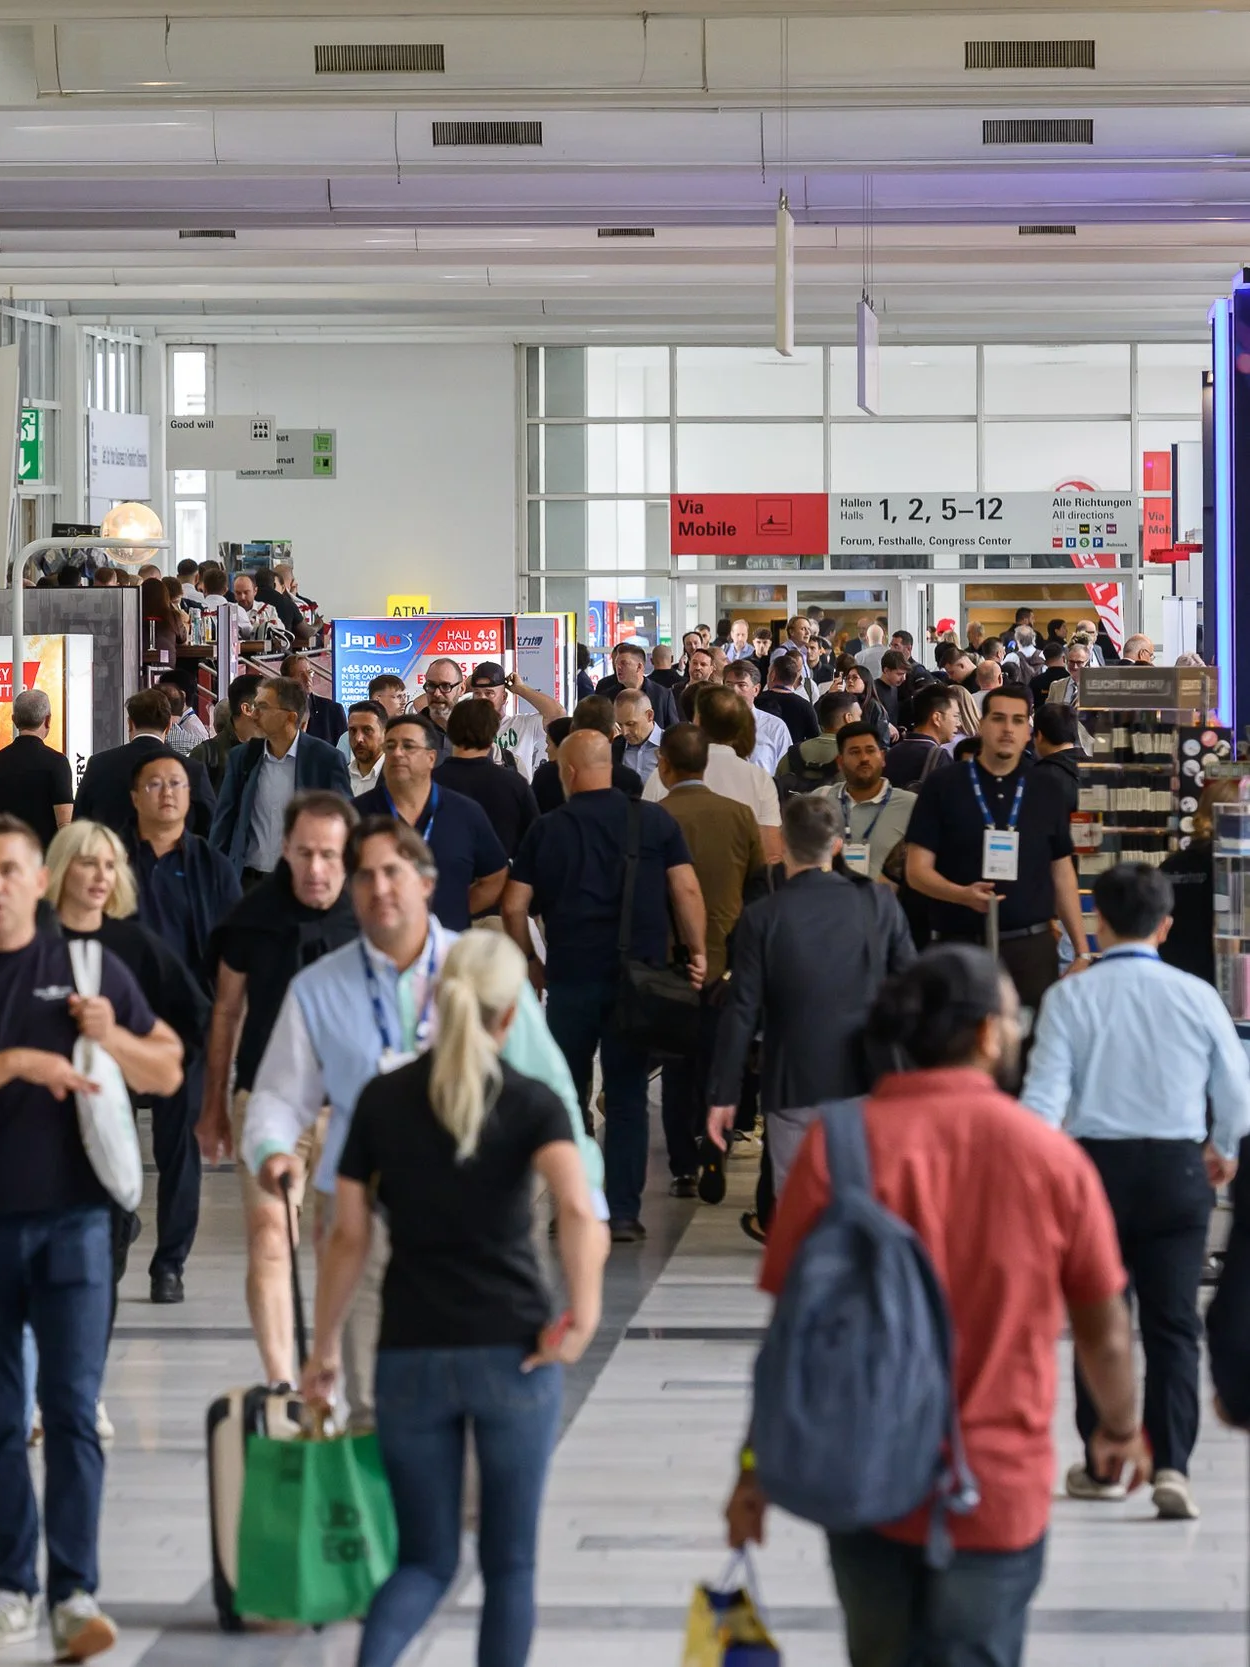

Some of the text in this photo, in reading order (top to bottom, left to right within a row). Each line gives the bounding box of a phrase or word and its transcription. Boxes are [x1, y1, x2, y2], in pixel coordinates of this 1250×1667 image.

[170, 419, 214, 429] Good will
[678, 499, 704, 515] Via
[840, 498, 872, 508] Hallen
[1052, 497, 1132, 509] Alle Richtungen
[840, 510, 864, 520] Halls
[879, 498, 898, 524] 1,
[908, 498, 931, 524] 2,
[1052, 510, 1115, 520] All directions
[1148, 511, 1165, 521] Via
[678, 521, 737, 537] Mobile
[1148, 524, 1171, 535] Mob
[840, 535, 1012, 548] Forum, Festhalle, Congress Center
[392, 606, 425, 617] ATM
[447, 629, 498, 640] HALL 4.0
[340, 632, 401, 649] JapKo
[437, 641, 497, 651] STAND D95
[341, 664, 382, 674] +65.000
